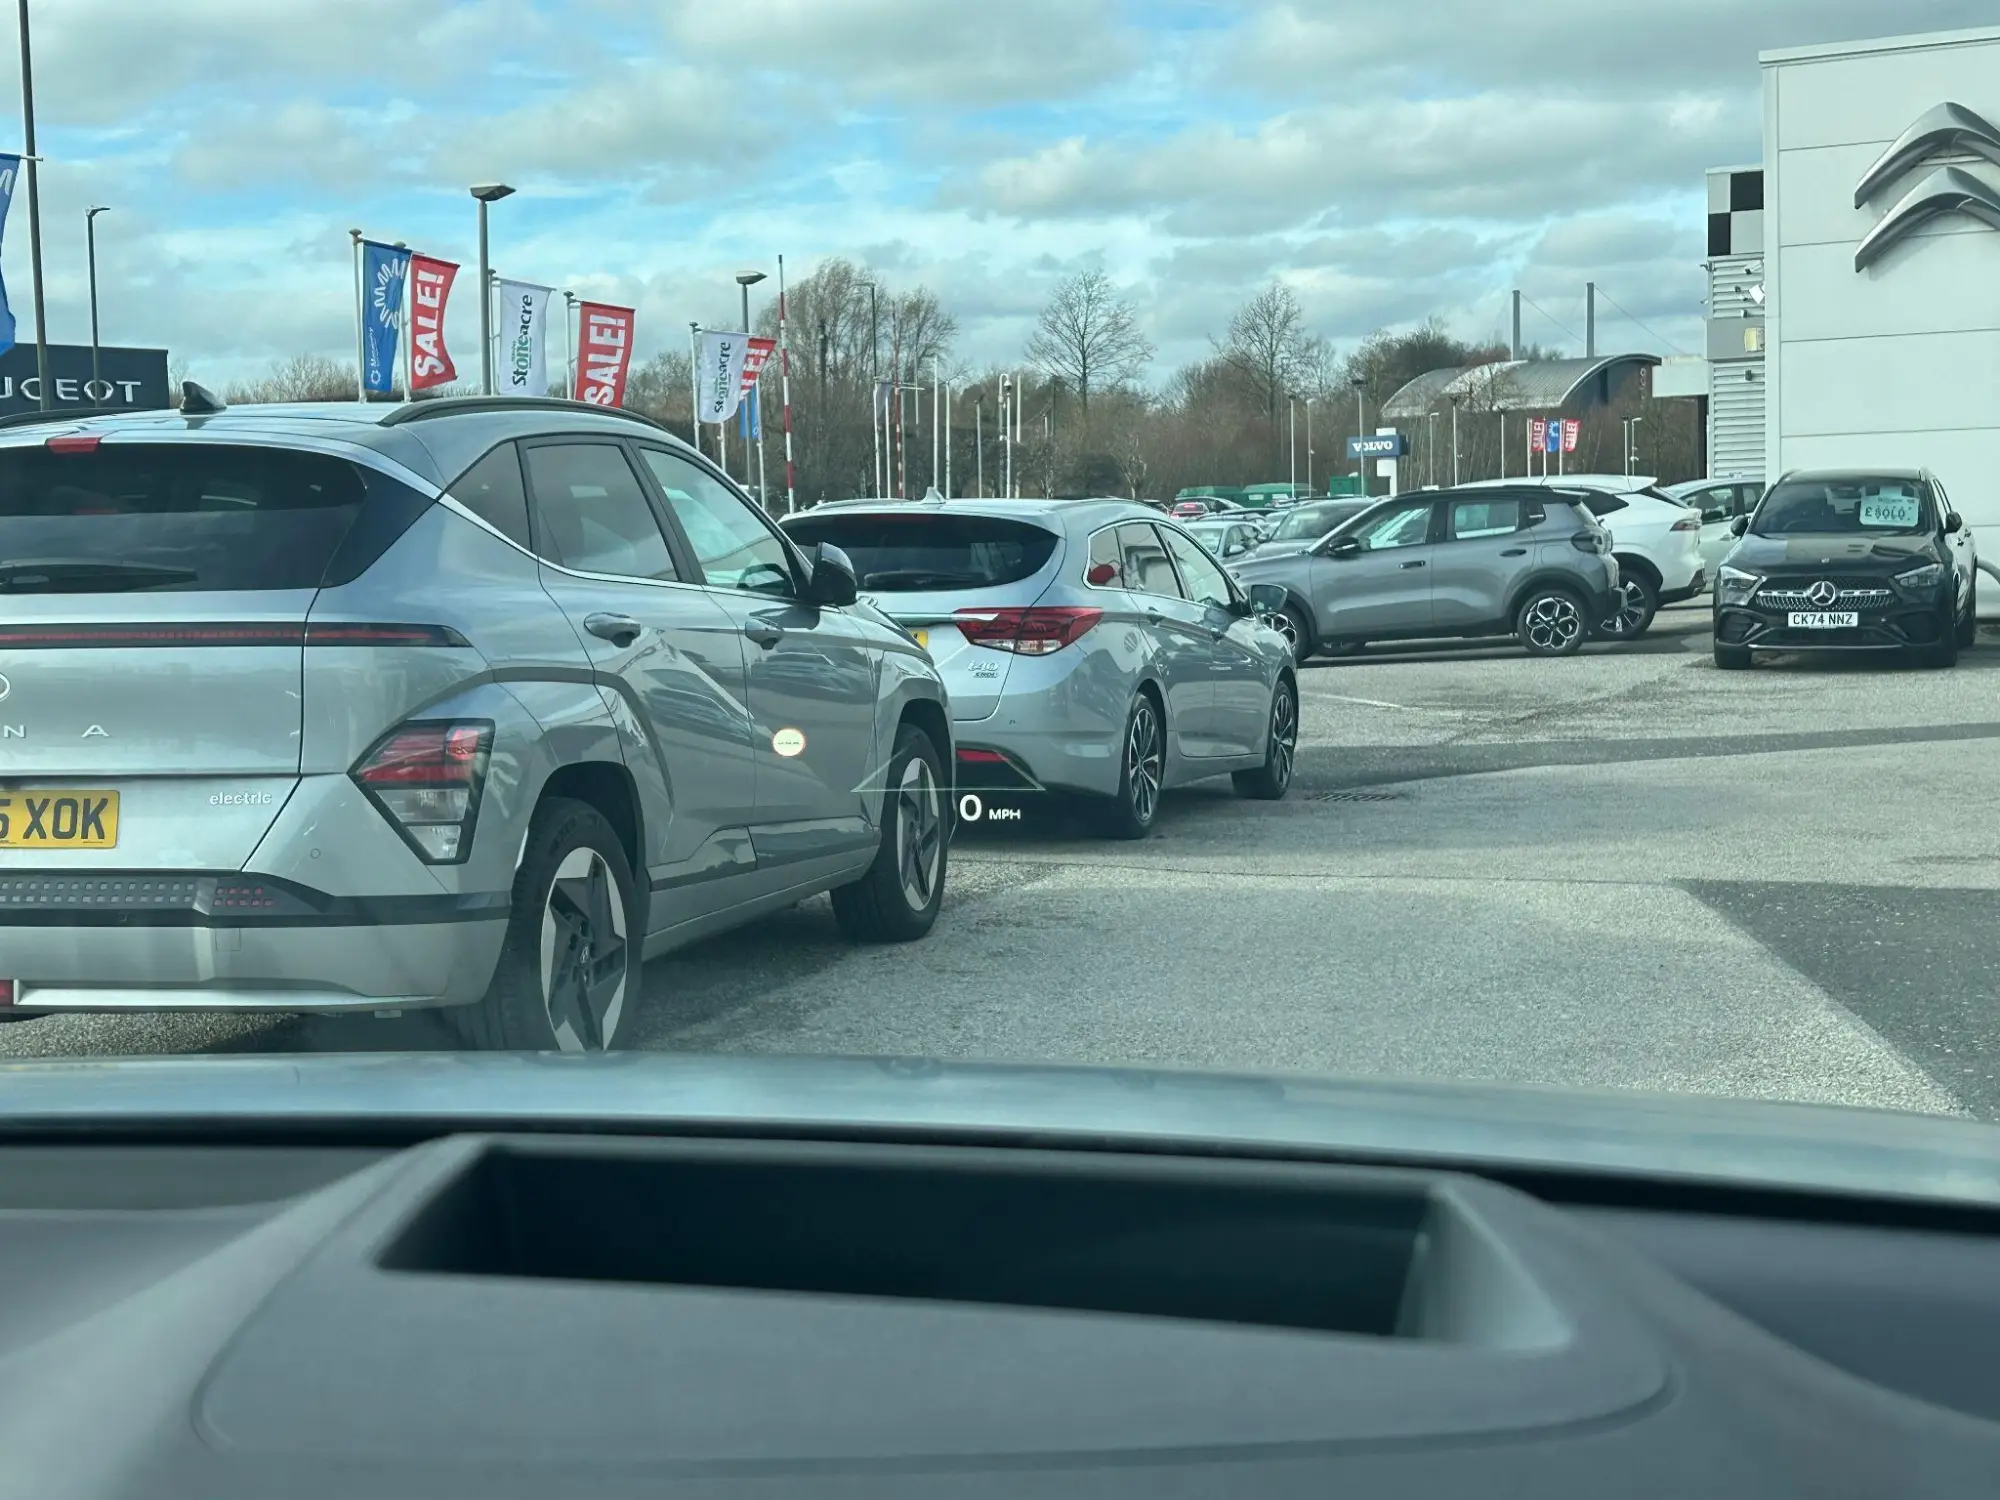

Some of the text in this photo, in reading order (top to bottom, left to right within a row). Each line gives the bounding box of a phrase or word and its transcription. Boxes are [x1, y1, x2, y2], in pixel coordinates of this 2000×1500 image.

[414, 269, 445, 377] SALE!
[512, 294, 533, 386] Stoneacre
[584, 314, 626, 405] SALE!
[1352, 440, 1393, 452] VOLVO
[1793, 613, 1853, 625] CK74 NNZ
[209, 790, 272, 806] electric
[959, 794, 1021, 822] 0 MPH
[22, 798, 109, 840] XOK
